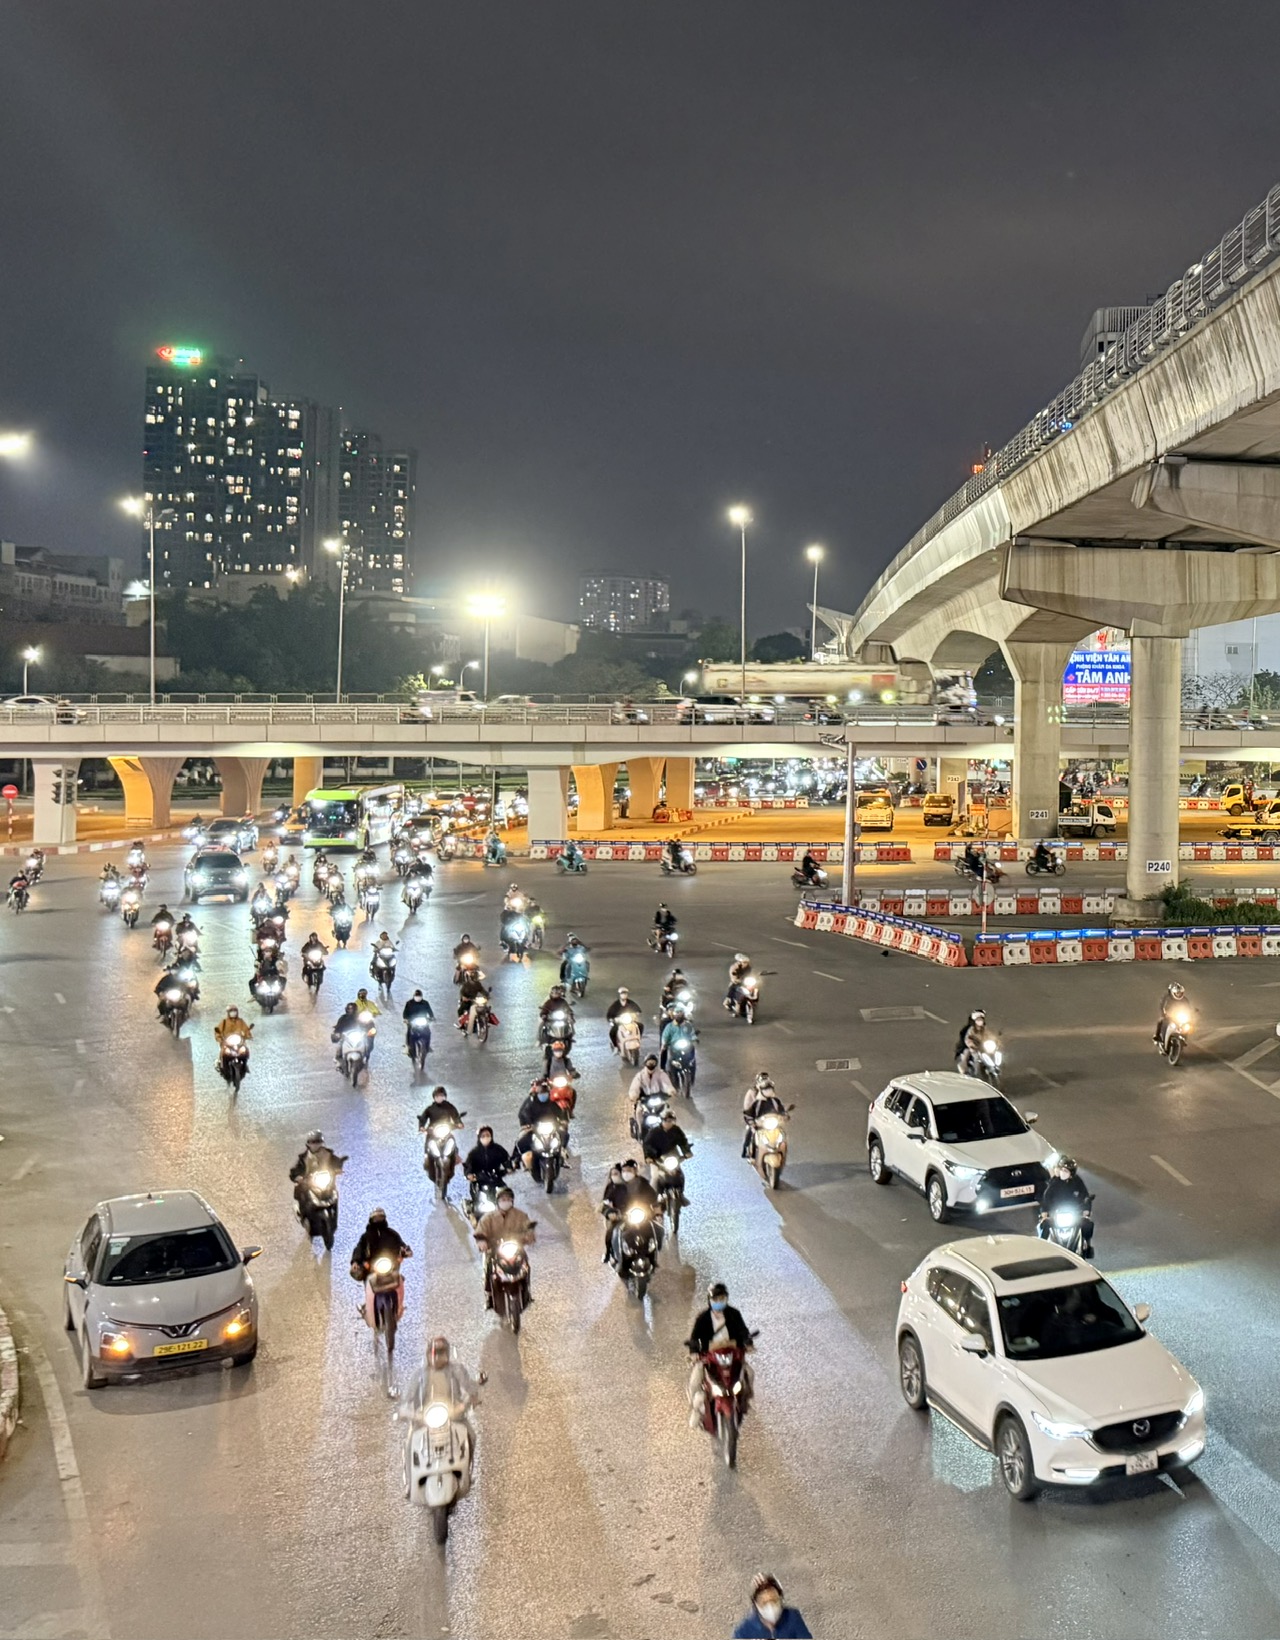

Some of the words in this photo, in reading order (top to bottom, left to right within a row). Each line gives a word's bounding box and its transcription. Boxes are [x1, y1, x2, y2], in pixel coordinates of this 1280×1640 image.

[1085, 653, 1102, 664] VIỆN
[1104, 653, 1119, 662] TÂM
[1121, 654, 1131, 662] AN
[1076, 670, 1102, 684] TÂM
[1148, 862, 1170, 872] P240
